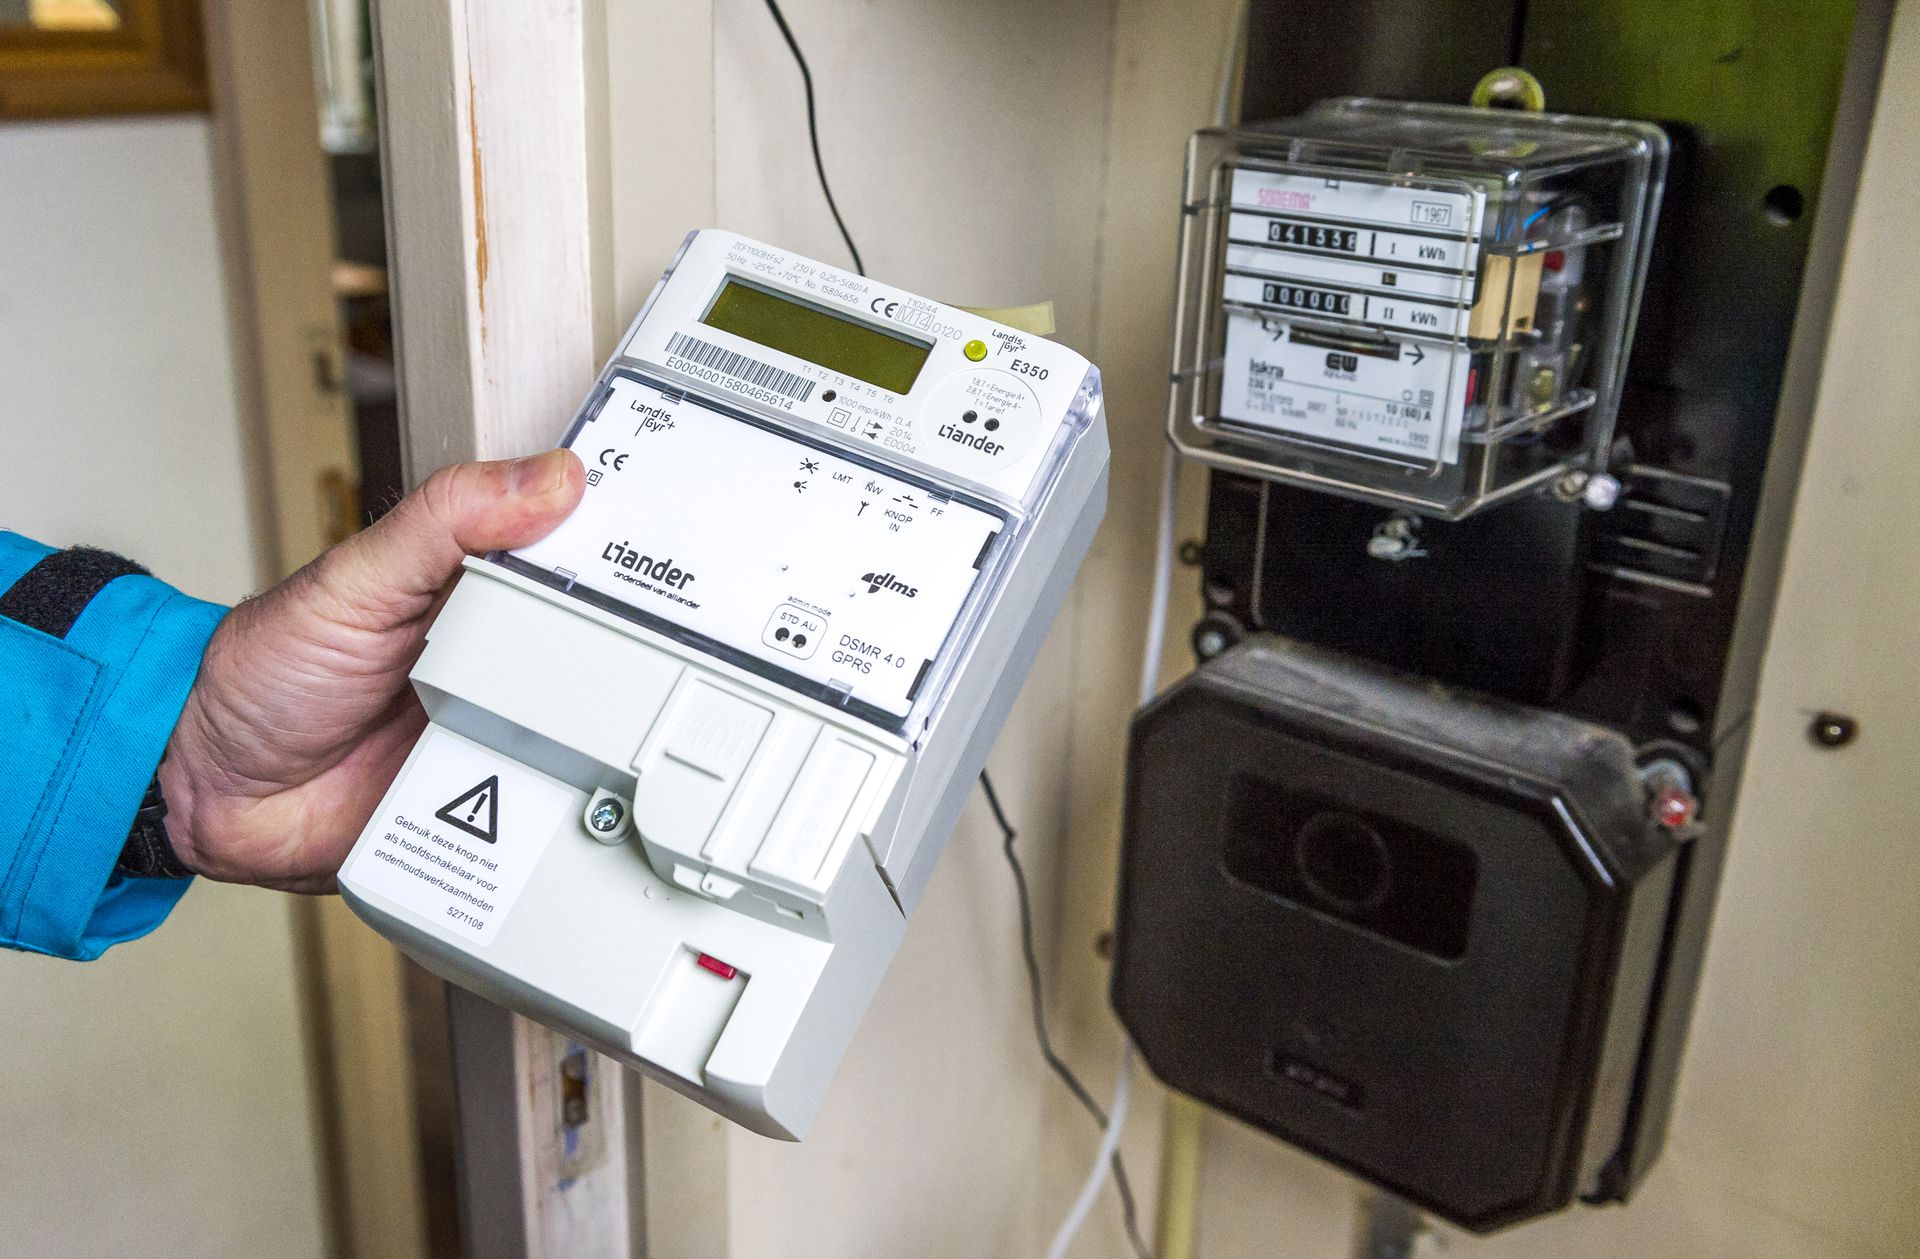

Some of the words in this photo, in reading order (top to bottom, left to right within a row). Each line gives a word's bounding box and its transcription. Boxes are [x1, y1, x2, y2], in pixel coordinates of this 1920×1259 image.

[1418, 244, 1446, 261] kWh
[793, 262, 808, 274] 230
[897, 305, 932, 329] M14
[931, 322, 963, 341] 0120
[1411, 310, 1438, 327] kWh
[991, 328, 1023, 346] Landis
[1009, 358, 1049, 381] E350
[665, 356, 795, 411] E0004001580465614
[801, 364, 812, 374] T1
[817, 370, 829, 380] T2
[833, 376, 845, 386] T3
[849, 382, 861, 392] T4
[866, 388, 877, 398] T5
[883, 394, 895, 404] T6
[989, 383, 1015, 400] Energie
[630, 399, 672, 422] Landis
[838, 395, 858, 409] 1000
[985, 392, 1012, 409] Energie
[883, 437, 917, 454] E0004
[888, 427, 913, 441] 2014
[937, 423, 1005, 457] Liander
[832, 471, 853, 484] LMT
[883, 508, 914, 524] KNOP
[930, 507, 944, 518] FF
[888, 522, 901, 532] IN
[601, 540, 696, 591] Liander
[613, 570, 653, 591] onderdeel
[653, 586, 667, 597] van
[666, 592, 701, 610] alliander
[872, 572, 919, 599] dlms
[787, 594, 810, 609] admin
[811, 604, 832, 617] mode
[780, 611, 800, 625] STD
[800, 620, 819, 632] AU
[831, 650, 873, 675] GPRS
[839, 634, 883, 660] DSMR
[883, 653, 906, 669] 4.0
[394, 815, 431, 840] Gebruik
[431, 834, 455, 851] deze
[454, 844, 479, 864] knop
[479, 858, 499, 872] niet
[383, 831, 400, 844] als
[399, 838, 477, 882] hoofdschakelaar
[476, 877, 499, 893] voor
[373, 848, 495, 914] onderhoudswerkzaamheden
[446, 906, 485, 931] 5271108
